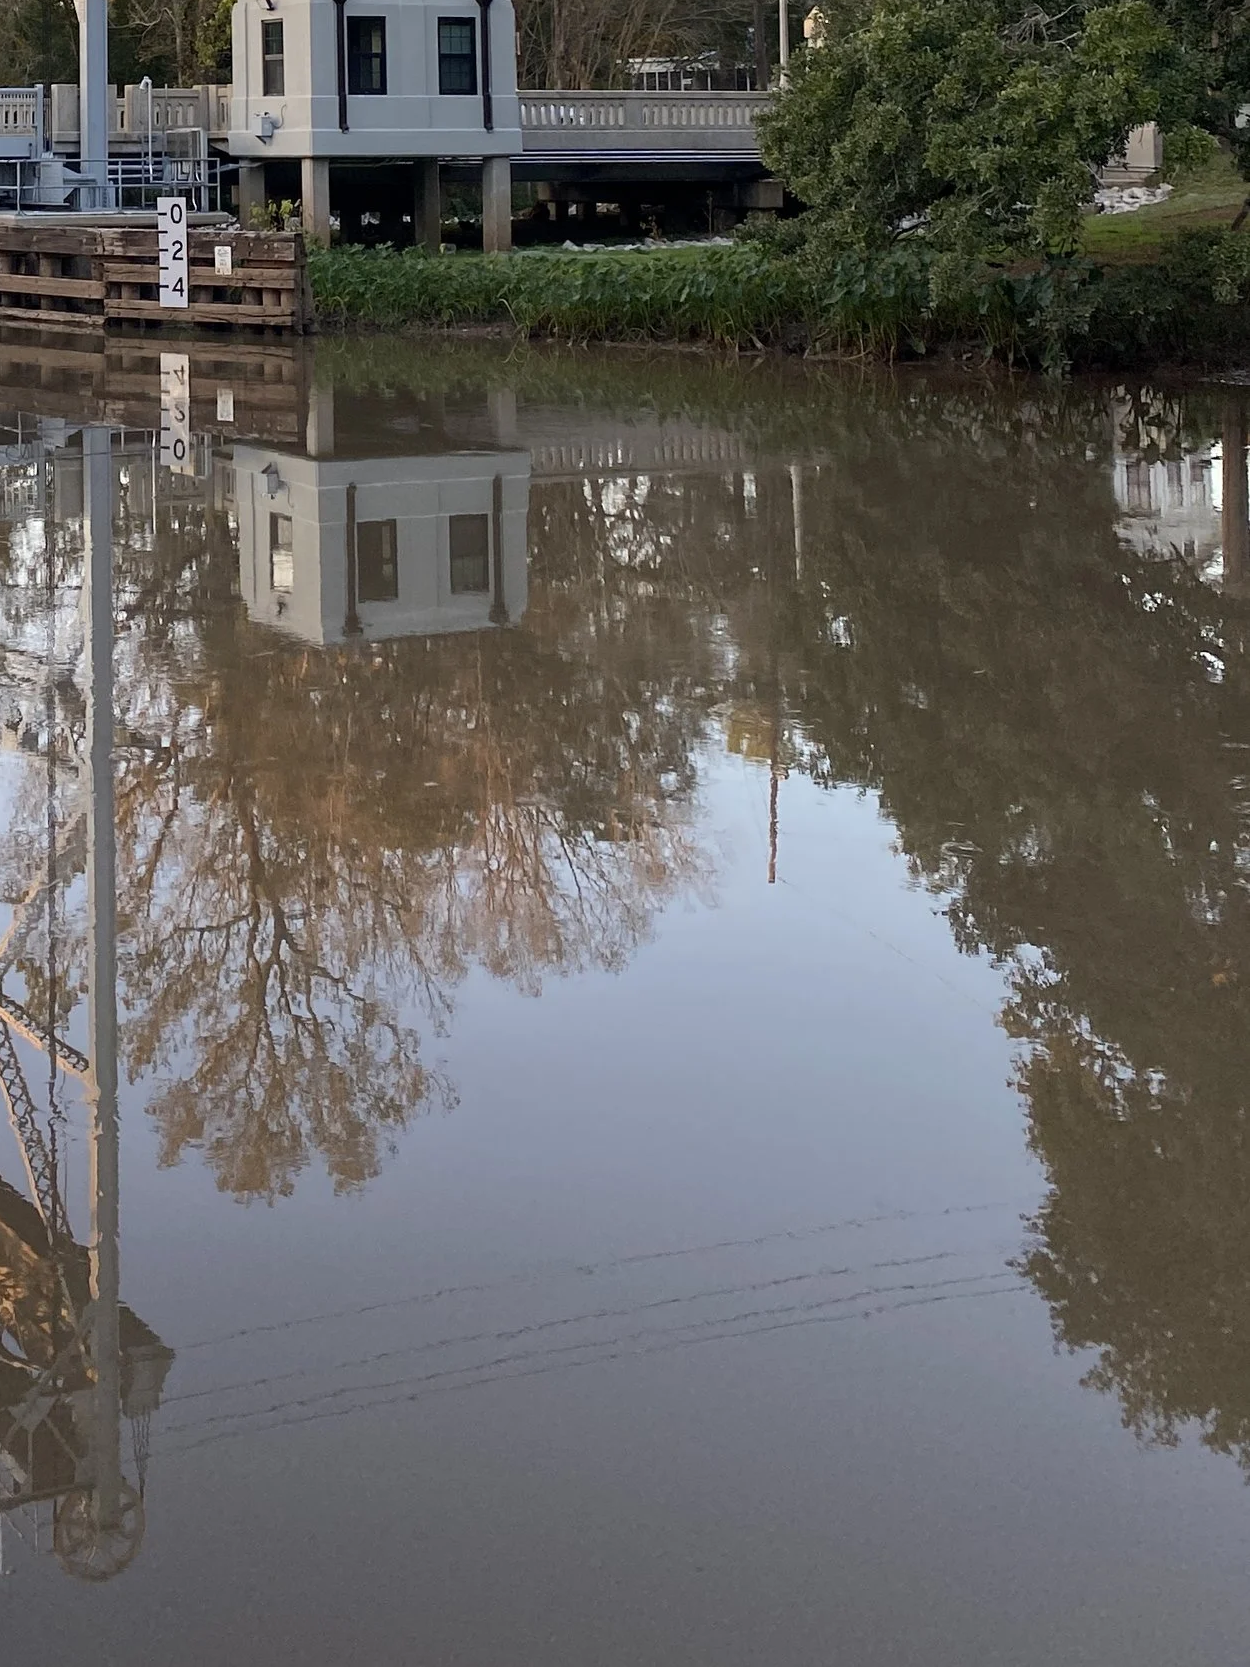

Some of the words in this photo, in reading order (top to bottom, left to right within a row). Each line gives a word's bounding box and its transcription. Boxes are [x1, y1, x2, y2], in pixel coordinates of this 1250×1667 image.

[170, 203, 183, 224] 0
[172, 240, 184, 261] 2
[171, 277, 185, 298] 4
